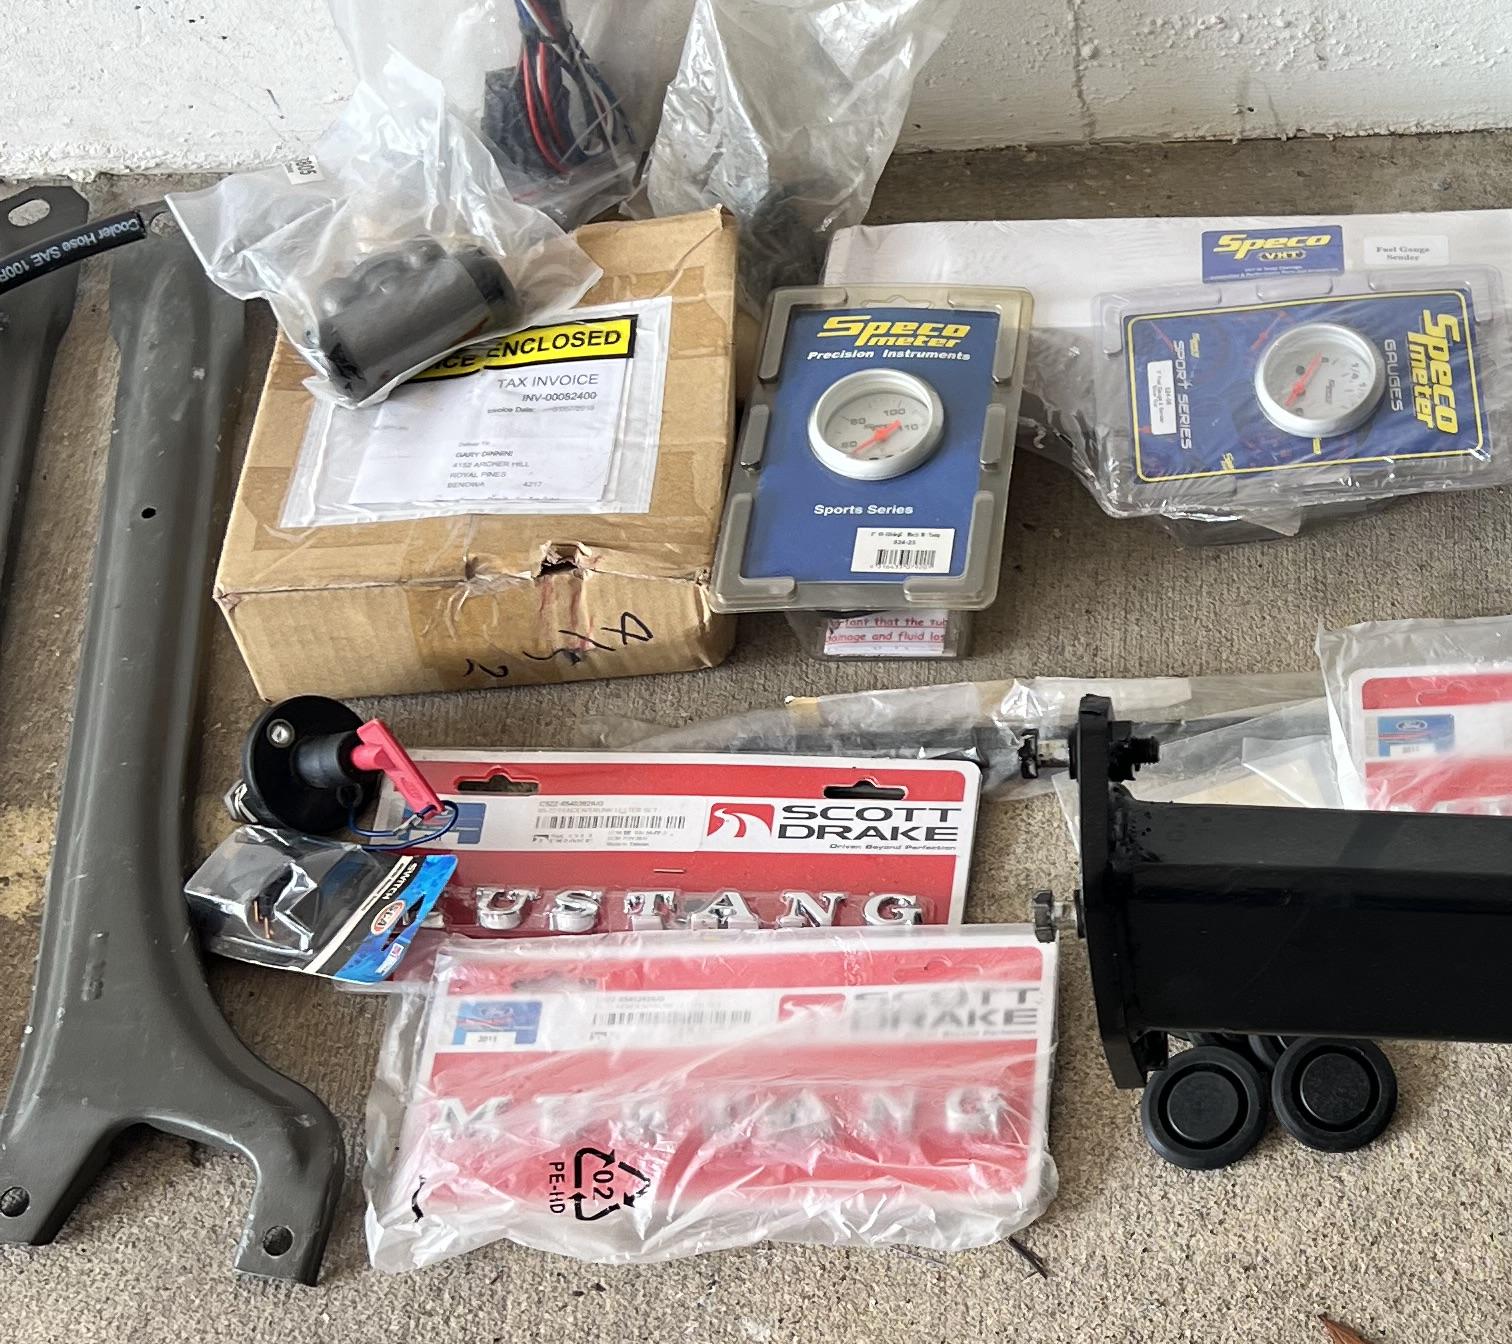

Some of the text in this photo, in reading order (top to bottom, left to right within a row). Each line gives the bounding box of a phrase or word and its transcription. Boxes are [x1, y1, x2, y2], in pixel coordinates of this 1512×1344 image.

[97, 218, 140, 240] Cooler
[61, 232, 98, 252] Hose
[1213, 234, 1332, 260] Speco
[29, 245, 62, 268] SAE
[817, 315, 971, 347] Speco
[867, 335, 962, 348] meter
[486, 329, 622, 359] ENCLOSED
[807, 349, 971, 361] Precision Instruments
[497, 374, 599, 390] TAX INVOICE
[1383, 338, 1404, 412] GAUGES
[1407, 309, 1460, 435] Speco
[1173, 340, 1193, 450] SPORT SERIES
[1408, 343, 1434, 430] meter
[813, 504, 914, 516] Sports Series
[874, 617, 900, 627] that
[905, 617, 924, 627] the
[871, 631, 893, 641] and
[898, 631, 925, 641] fluid
[782, 805, 962, 823] SCOTT
[778, 824, 959, 841] DRAKE
[381, 861, 418, 901] SWITCH
[425, 886, 926, 932] USTANG
[549, 1161, 566, 1214] PE-HD
[592, 1169, 614, 1201] 02
